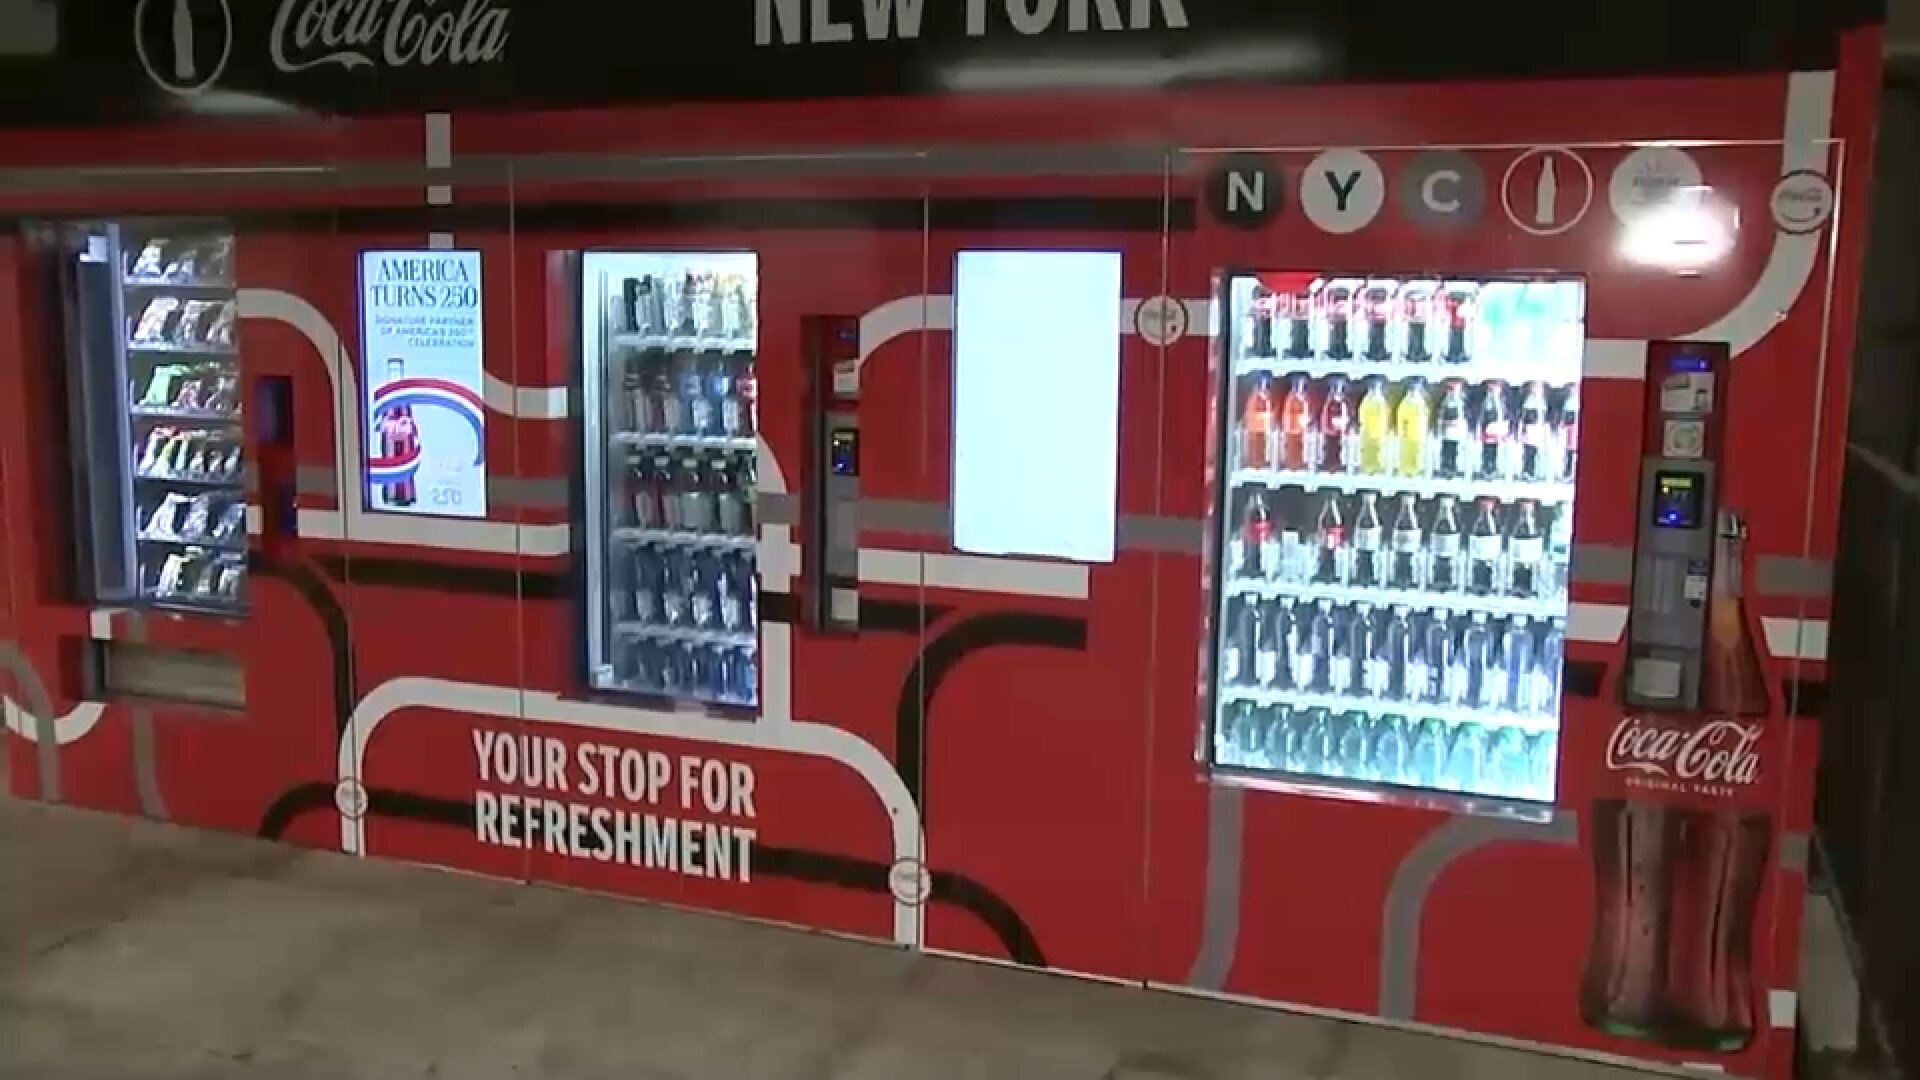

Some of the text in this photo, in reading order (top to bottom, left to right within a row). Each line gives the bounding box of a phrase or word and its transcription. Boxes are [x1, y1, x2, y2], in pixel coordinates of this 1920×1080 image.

[270, 0, 510, 71] CocaCola
[1226, 170, 1461, 212] N Y C
[370, 284, 477, 308] TURNS 250
[378, 258, 469, 283] AMERICA
[472, 728, 757, 818] YOUR STOP FOR
[1606, 717, 1764, 784] Coca-Cola
[475, 791, 757, 883] REFRESHMENT
